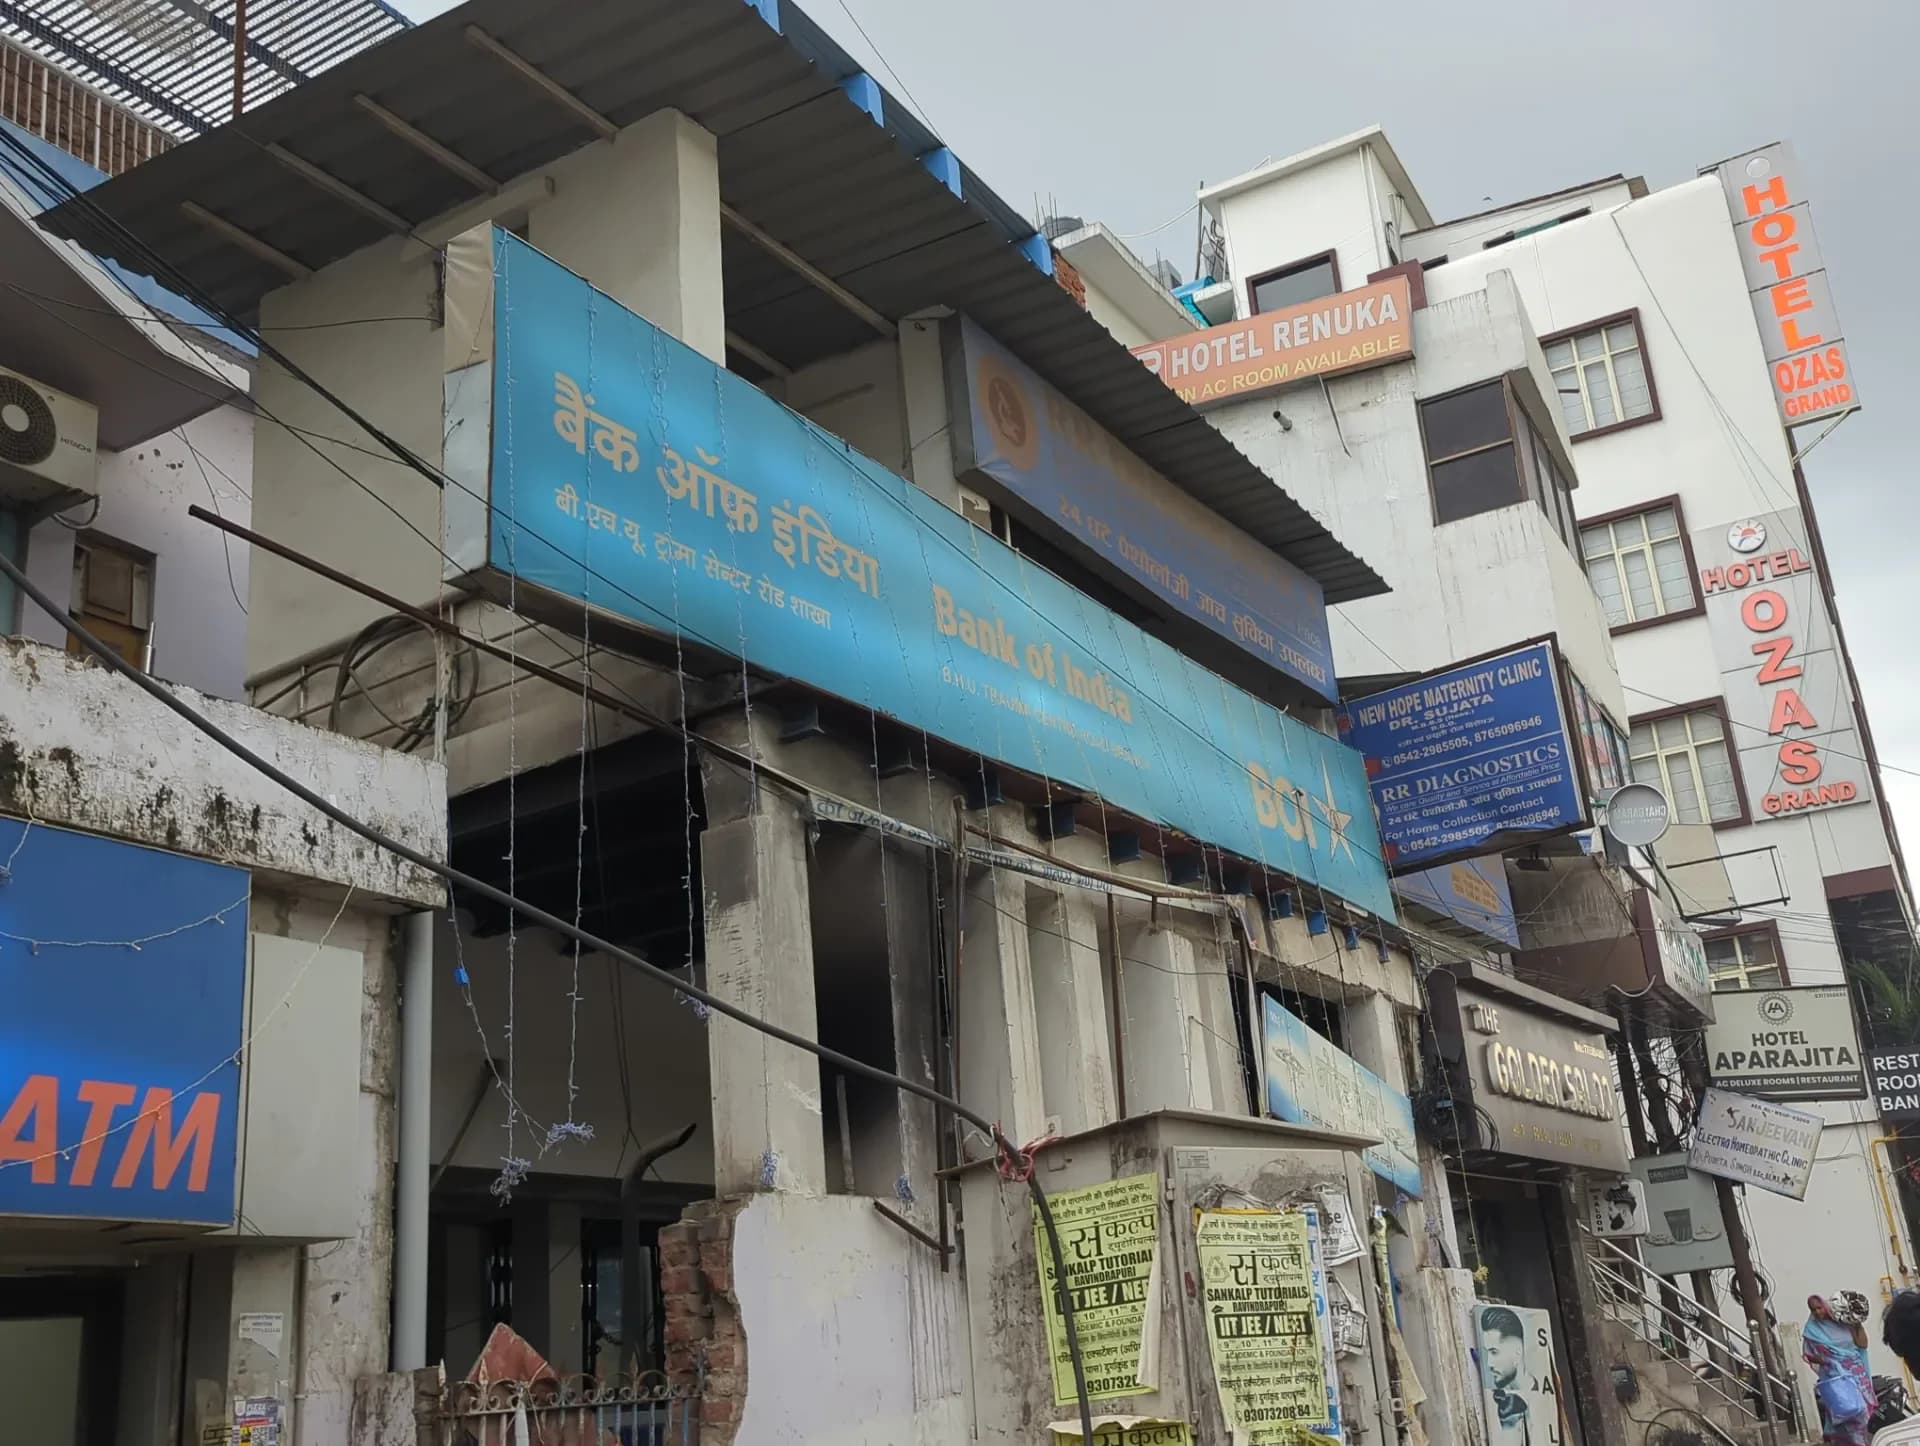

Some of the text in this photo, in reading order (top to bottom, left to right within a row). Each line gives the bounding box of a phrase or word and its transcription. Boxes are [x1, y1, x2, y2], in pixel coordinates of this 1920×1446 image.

[1741, 175, 1823, 352] HOTEL
[1171, 293, 1399, 378] HOTEL RENUKA
[1202, 379, 1227, 396] AC
[1232, 363, 1289, 389] ROOM
[1294, 334, 1402, 373] AVAILABLE
[1775, 347, 1845, 394] OZAS
[1783, 383, 1853, 417] GRAND
[553, 371, 640, 473] बैंक
[770, 498, 880, 600] इंडिया
[1702, 548, 1811, 593] HOTEL
[932, 584, 1133, 725] Bank of India
[1358, 658, 1542, 728] NEW HOPE MATERNITY CLINIC
[1740, 589, 1822, 785] OZAS
[1388, 693, 1495, 731] DR. SUJATA
[1474, 714, 1543, 743] 8765096946
[1381, 743, 1560, 803] RR DIAGNOSTICS
[1247, 759, 1319, 851] BOI
[1385, 796, 1545, 842] For Home Collection Contact
[1761, 781, 1857, 815] GRAND
[1387, 816, 1403, 826] 24
[1472, 1003, 1501, 1034] THE
[1752, 1031, 1809, 1047] HOTEL
[1491, 1041, 1564, 1107] GOLDEN
[1715, 1046, 1855, 1071] APARAJITA
[1730, 1078, 1763, 1088] DELUXE
[1763, 1076, 1797, 1086] ROOMS
[1801, 1074, 1860, 1085] RESTAURANT
[1877, 1073, 1920, 1091] ROO
[0, 1074, 221, 1192] ATM
[1697, 1127, 1731, 1149] ELECTRO
[1782, 1149, 1808, 1170] CLINIC
[1726, 1106, 1814, 1150] SANJEEVANI
[1067, 1214, 1156, 1260] संकल्प
[1046, 1259, 1097, 1280] SKALP
[1074, 1266, 1137, 1287] RAVINDRAPURI
[1227, 1250, 1303, 1287] संकल्प
[1084, 1286, 1109, 1308] JEE
[1207, 1286, 1309, 1302] SANKALP TUTORIALS
[1233, 1300, 1288, 1313] RAVINDRAPURI
[1219, 1316, 1239, 1336] IIT
[1241, 1315, 1263, 1336] JEE
